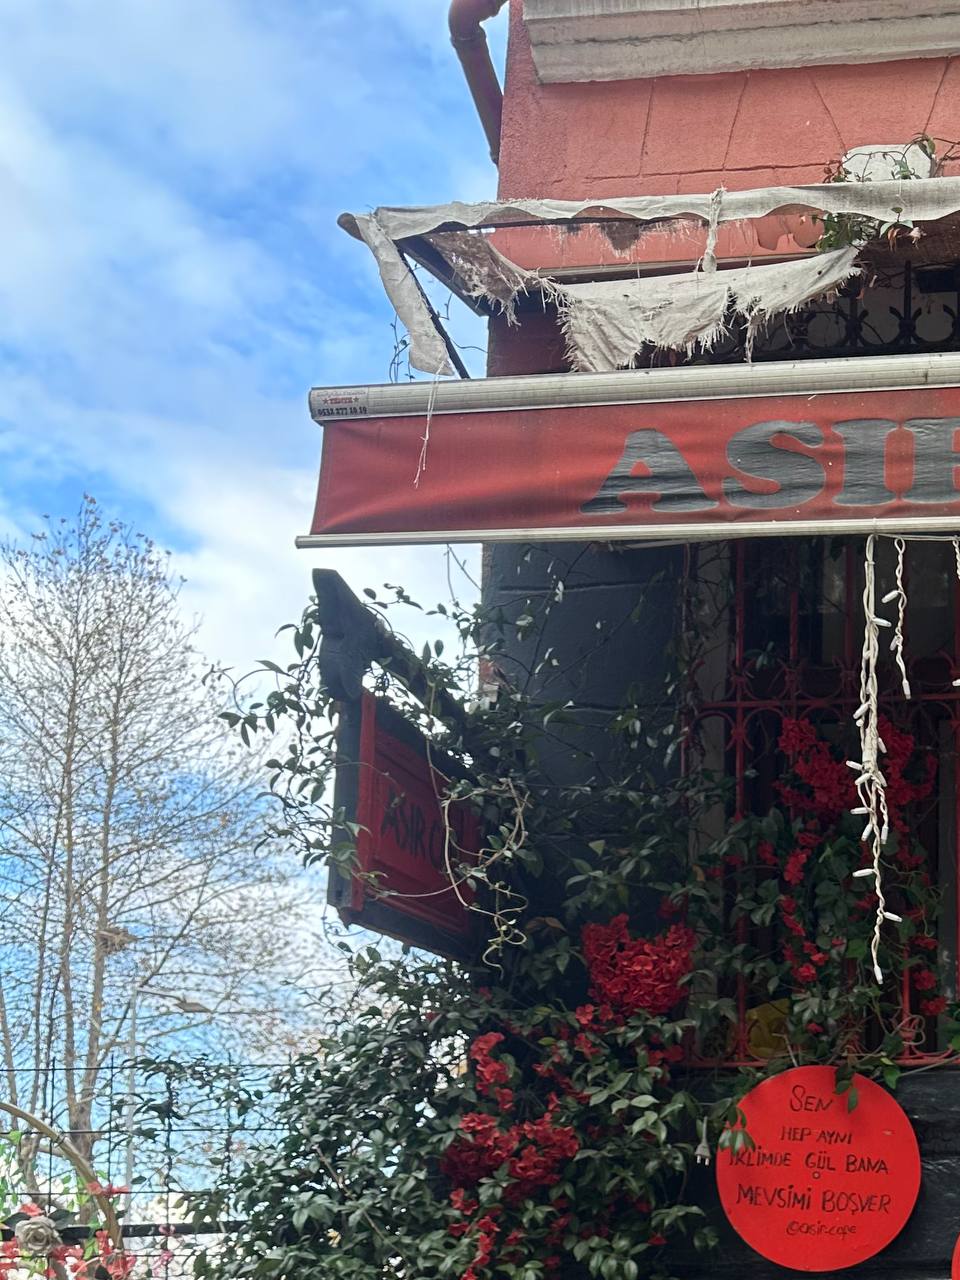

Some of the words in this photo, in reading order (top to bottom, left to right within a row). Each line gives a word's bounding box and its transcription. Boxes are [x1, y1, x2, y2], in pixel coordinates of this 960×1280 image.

[780, 1126, 812, 1142] HEP
[805, 1151, 836, 1171] GÜL
[845, 1154, 889, 1174] BANA
